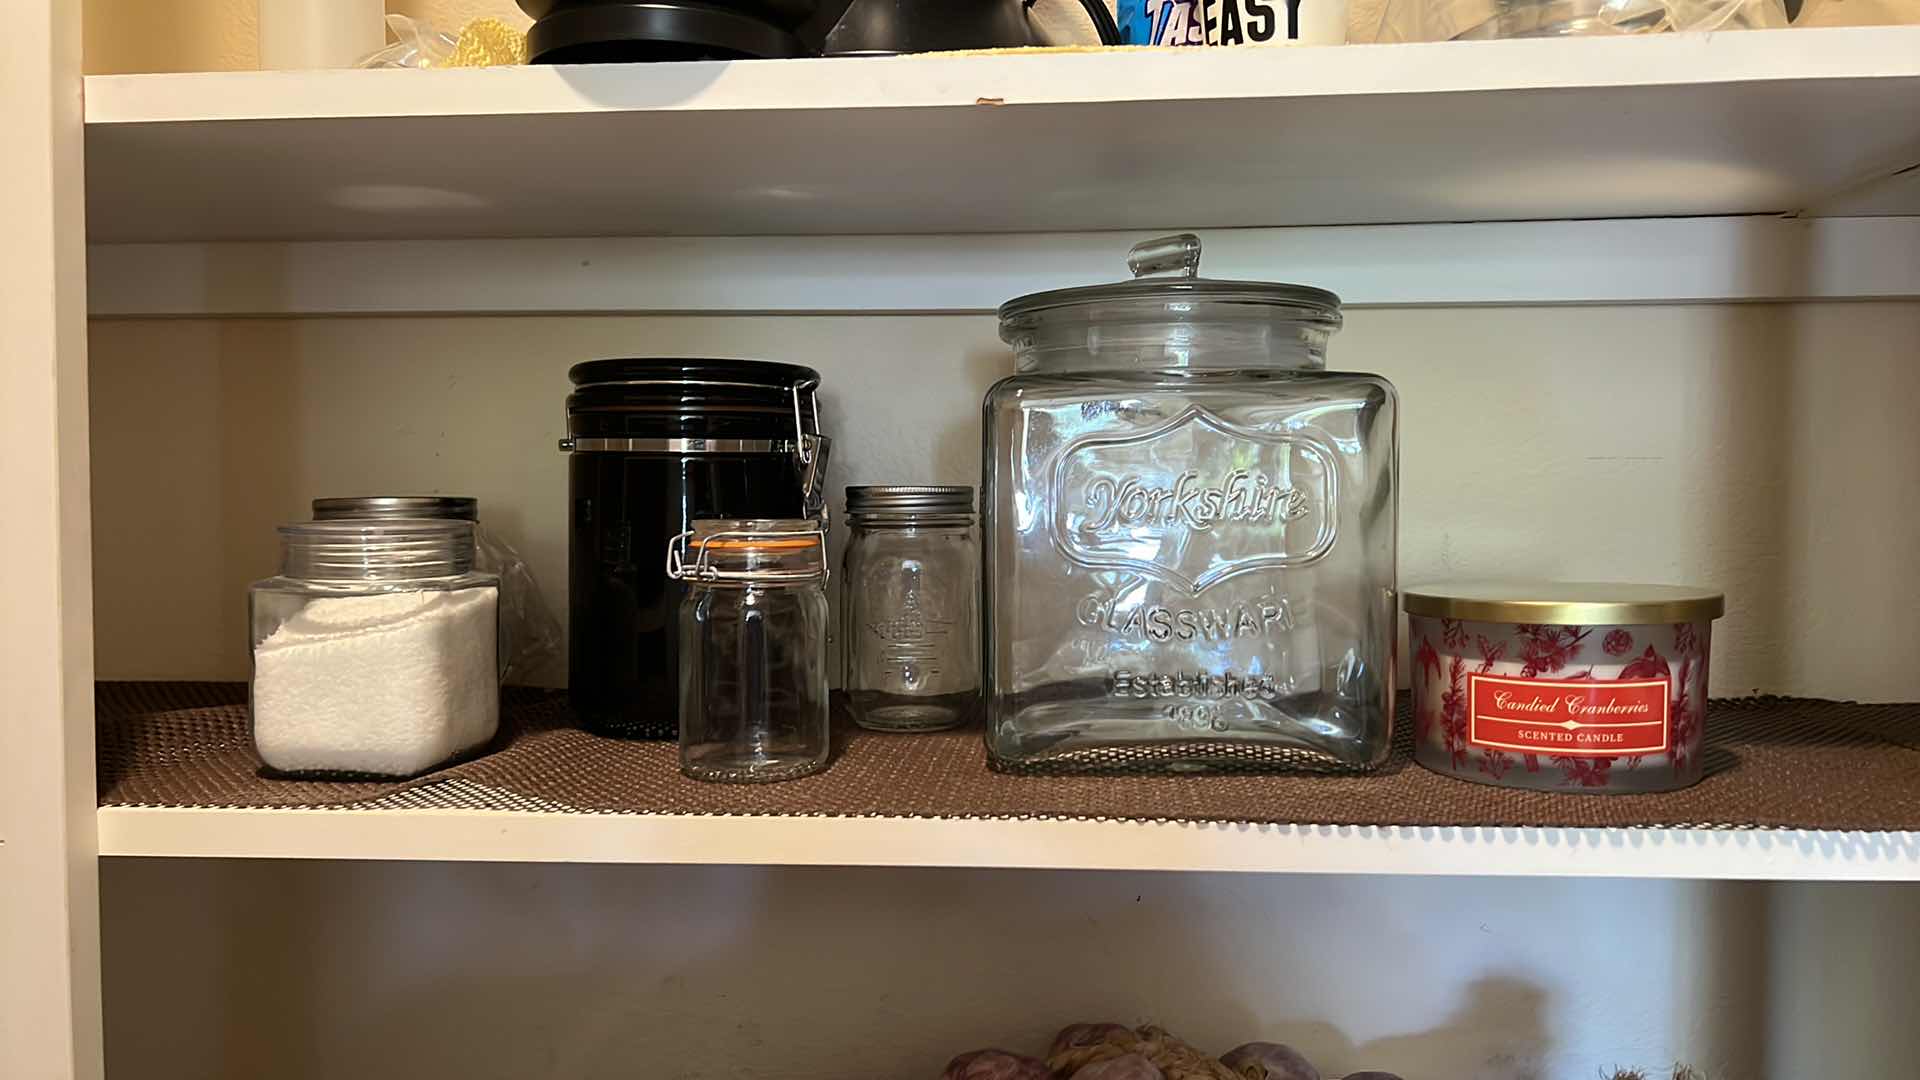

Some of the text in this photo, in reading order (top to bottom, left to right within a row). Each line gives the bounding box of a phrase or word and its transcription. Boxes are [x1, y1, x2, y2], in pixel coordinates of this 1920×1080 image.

[1081, 469, 1310, 531] Yorkshire
[1494, 690, 1649, 716] Candied Cranberries
[1518, 730, 1624, 743] SCENTED CANDLE
